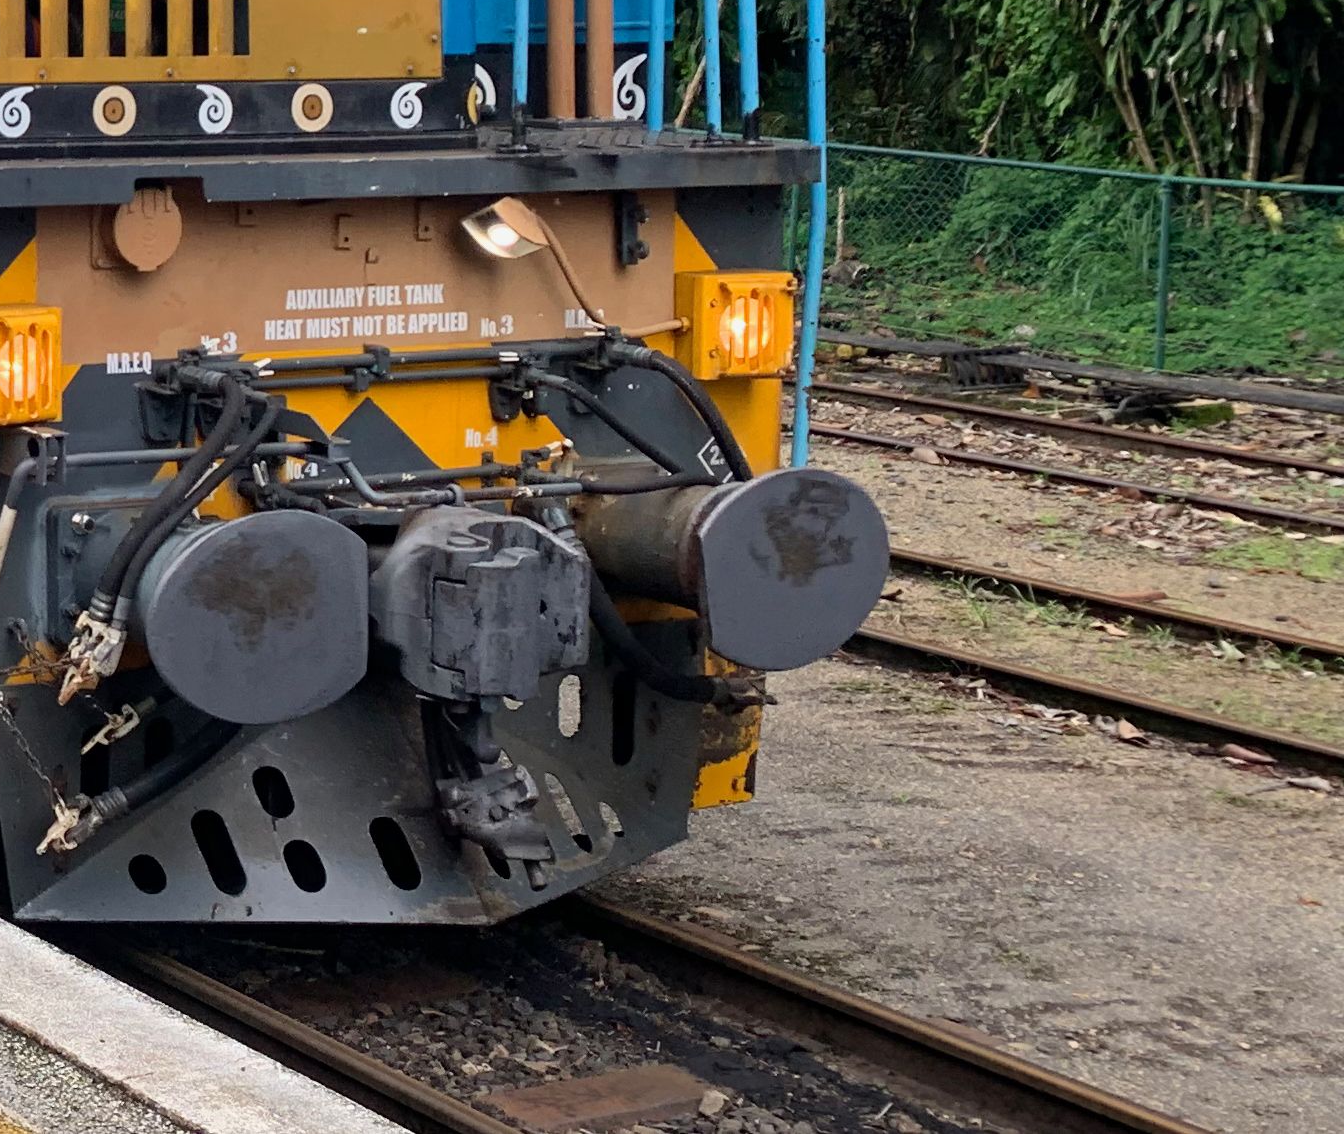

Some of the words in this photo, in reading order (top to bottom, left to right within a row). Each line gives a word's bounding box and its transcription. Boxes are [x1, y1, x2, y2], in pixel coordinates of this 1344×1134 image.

[286, 287, 365, 310] AUXILIARY
[367, 286, 402, 307] FUEL
[405, 284, 444, 305] TANK
[265, 319, 303, 340] HEAT
[306, 316, 351, 339] MUST
[353, 314, 383, 337] NOT
[386, 314, 405, 335] BE
[408, 312, 468, 334] APPLIED
